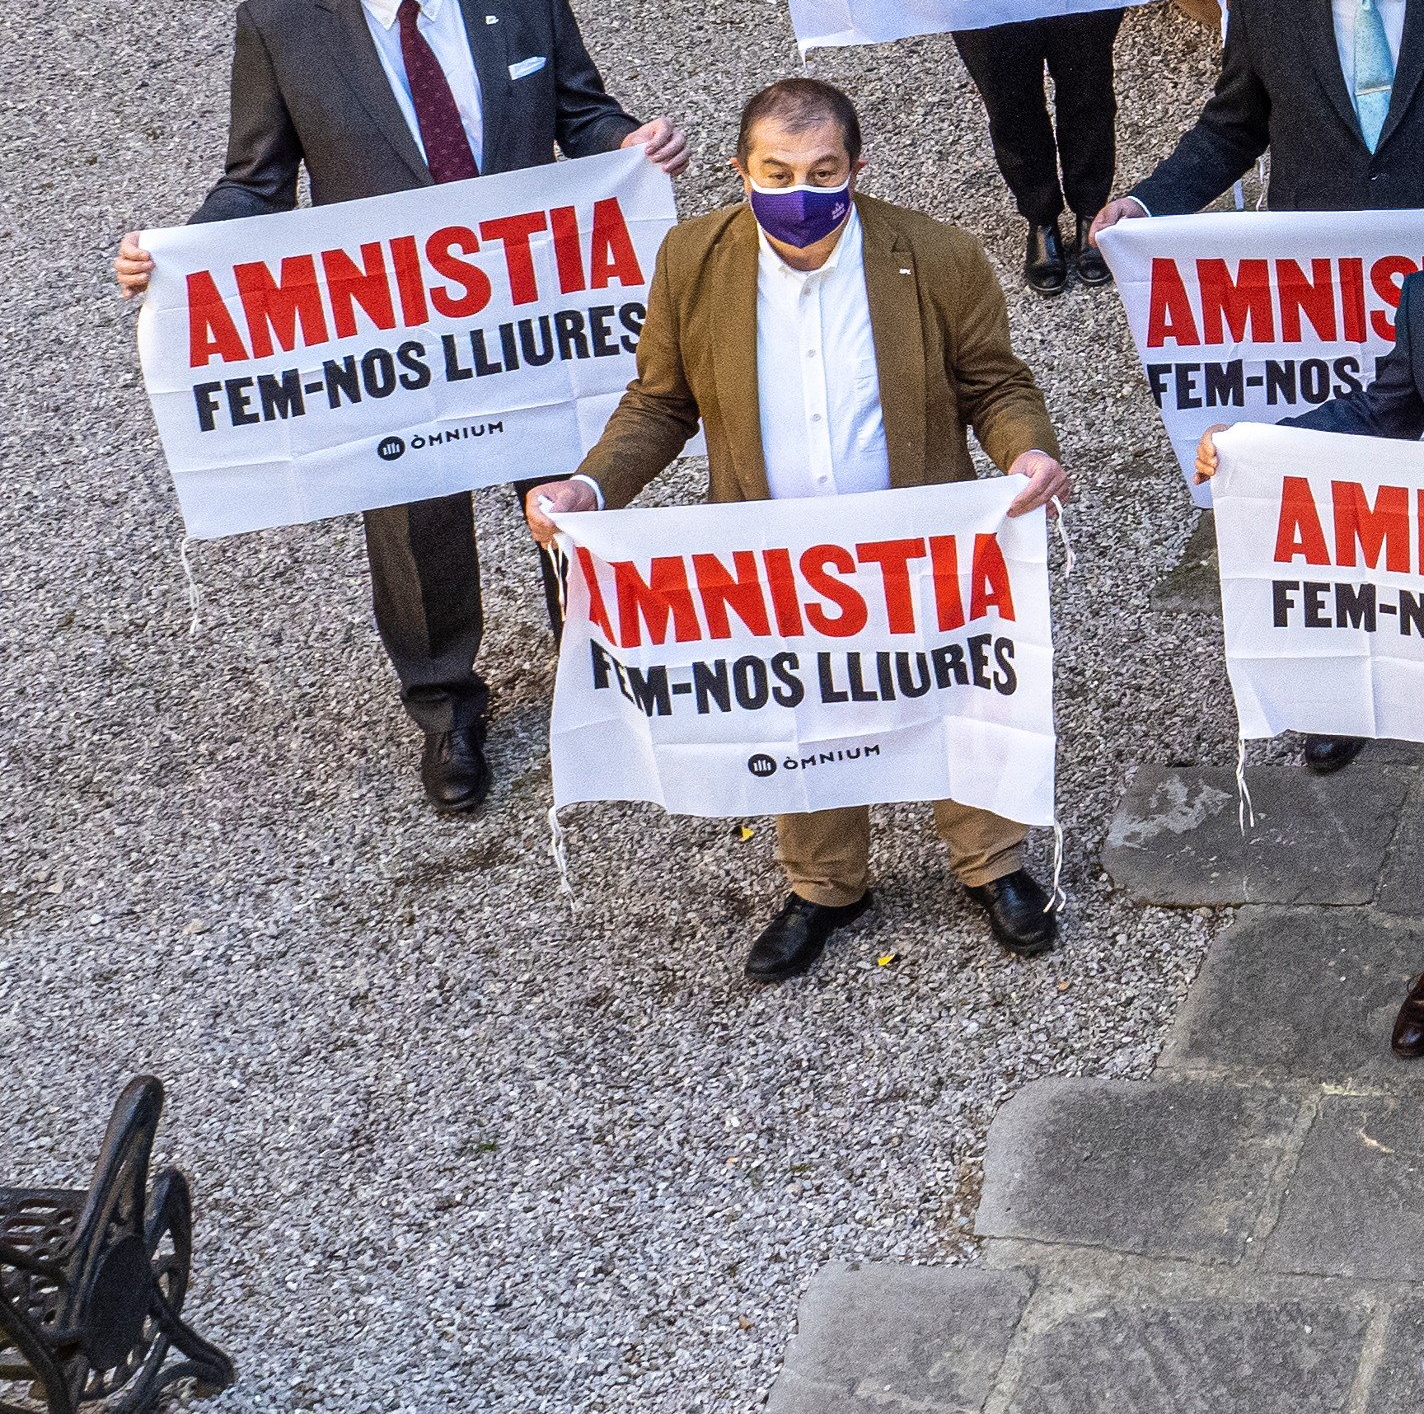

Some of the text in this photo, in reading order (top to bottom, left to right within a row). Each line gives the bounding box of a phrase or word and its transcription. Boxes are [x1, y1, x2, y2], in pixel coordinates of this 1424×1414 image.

[186, 196, 646, 368] AMNISTIA
[192, 301, 647, 432] FEM-NOS LLIURES
[1146, 356, 1364, 410] FEM-NOS
[410, 421, 504, 450] ÒMNIUM
[818, 633, 1017, 703] LLIURES
[783, 744, 880, 770] ÒMNIUM
